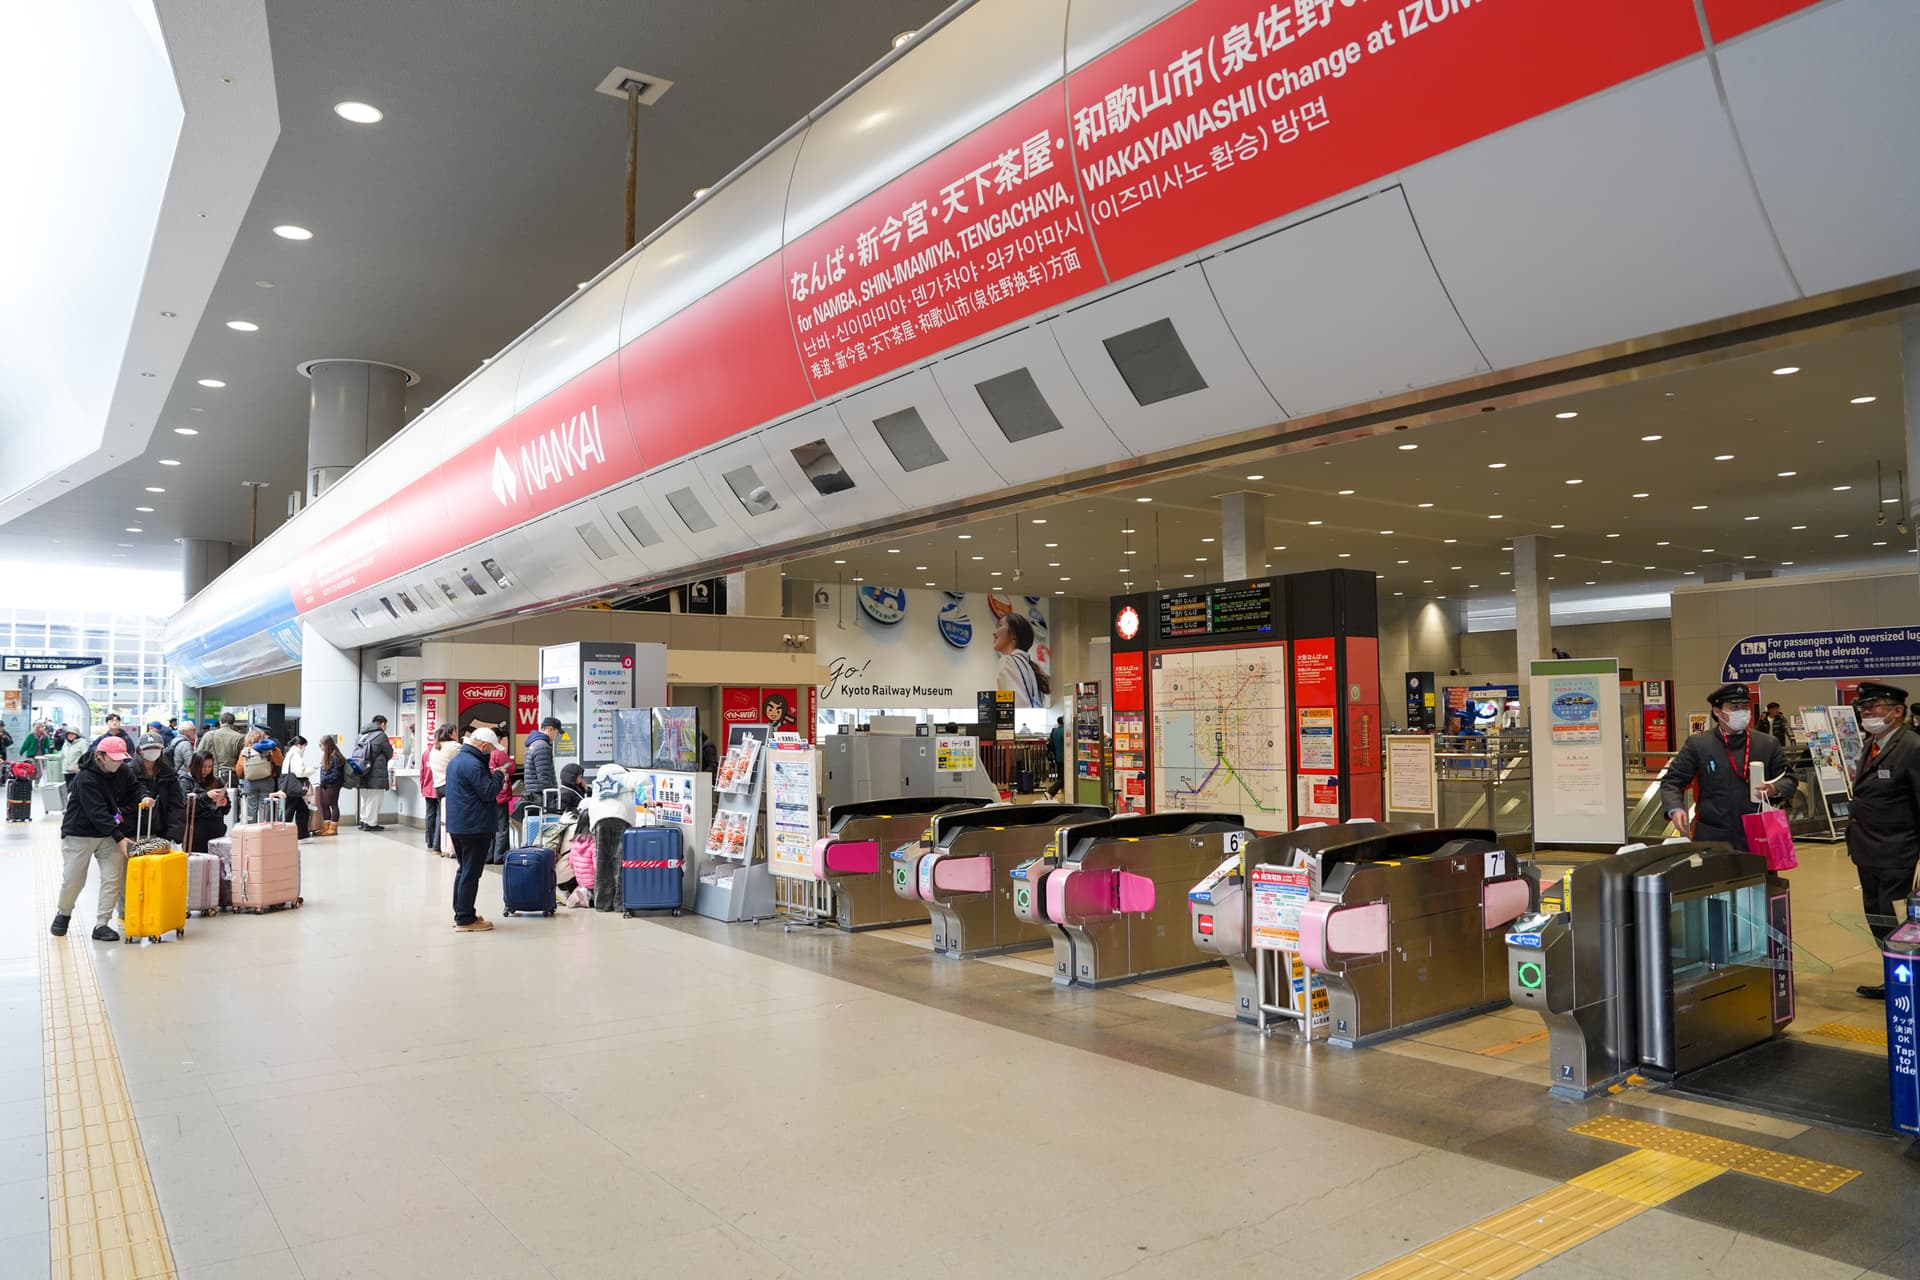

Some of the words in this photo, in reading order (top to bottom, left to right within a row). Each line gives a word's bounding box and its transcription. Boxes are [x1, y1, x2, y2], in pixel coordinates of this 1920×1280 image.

[1208, 125, 1269, 172] 환승)
[1271, 95, 1330, 143] 방면
[797, 313, 813, 334] for
[812, 288, 862, 324] NAMBA,
[860, 238, 961, 303] SHIN-IMAMIYA,
[957, 181, 1075, 253] TENGACHAYA,
[1366, 20, 1396, 54] at
[520, 404, 606, 496] NANKAI
[1767, 638, 1783, 648] For
[1783, 637, 1833, 649] passengers
[1835, 633, 1856, 644] with
[1859, 631, 1905, 643] oversized
[1768, 649, 1796, 661] please
[1797, 650, 1813, 658] use
[1815, 647, 1830, 657] the
[1832, 646, 1873, 656] elevator.
[841, 685, 870, 698] Kyoto
[872, 685, 911, 698] Railway
[912, 685, 953, 696] Museum
[1230, 833, 1239, 851] 6
[1491, 854, 1498, 876] 7
[1892, 1015, 1914, 1025] タッチ
[1898, 1035, 1910, 1044] OK
[1895, 1045, 1915, 1057] Tap
[1899, 1056, 1911, 1065] to
[1896, 1064, 1917, 1075] ride
